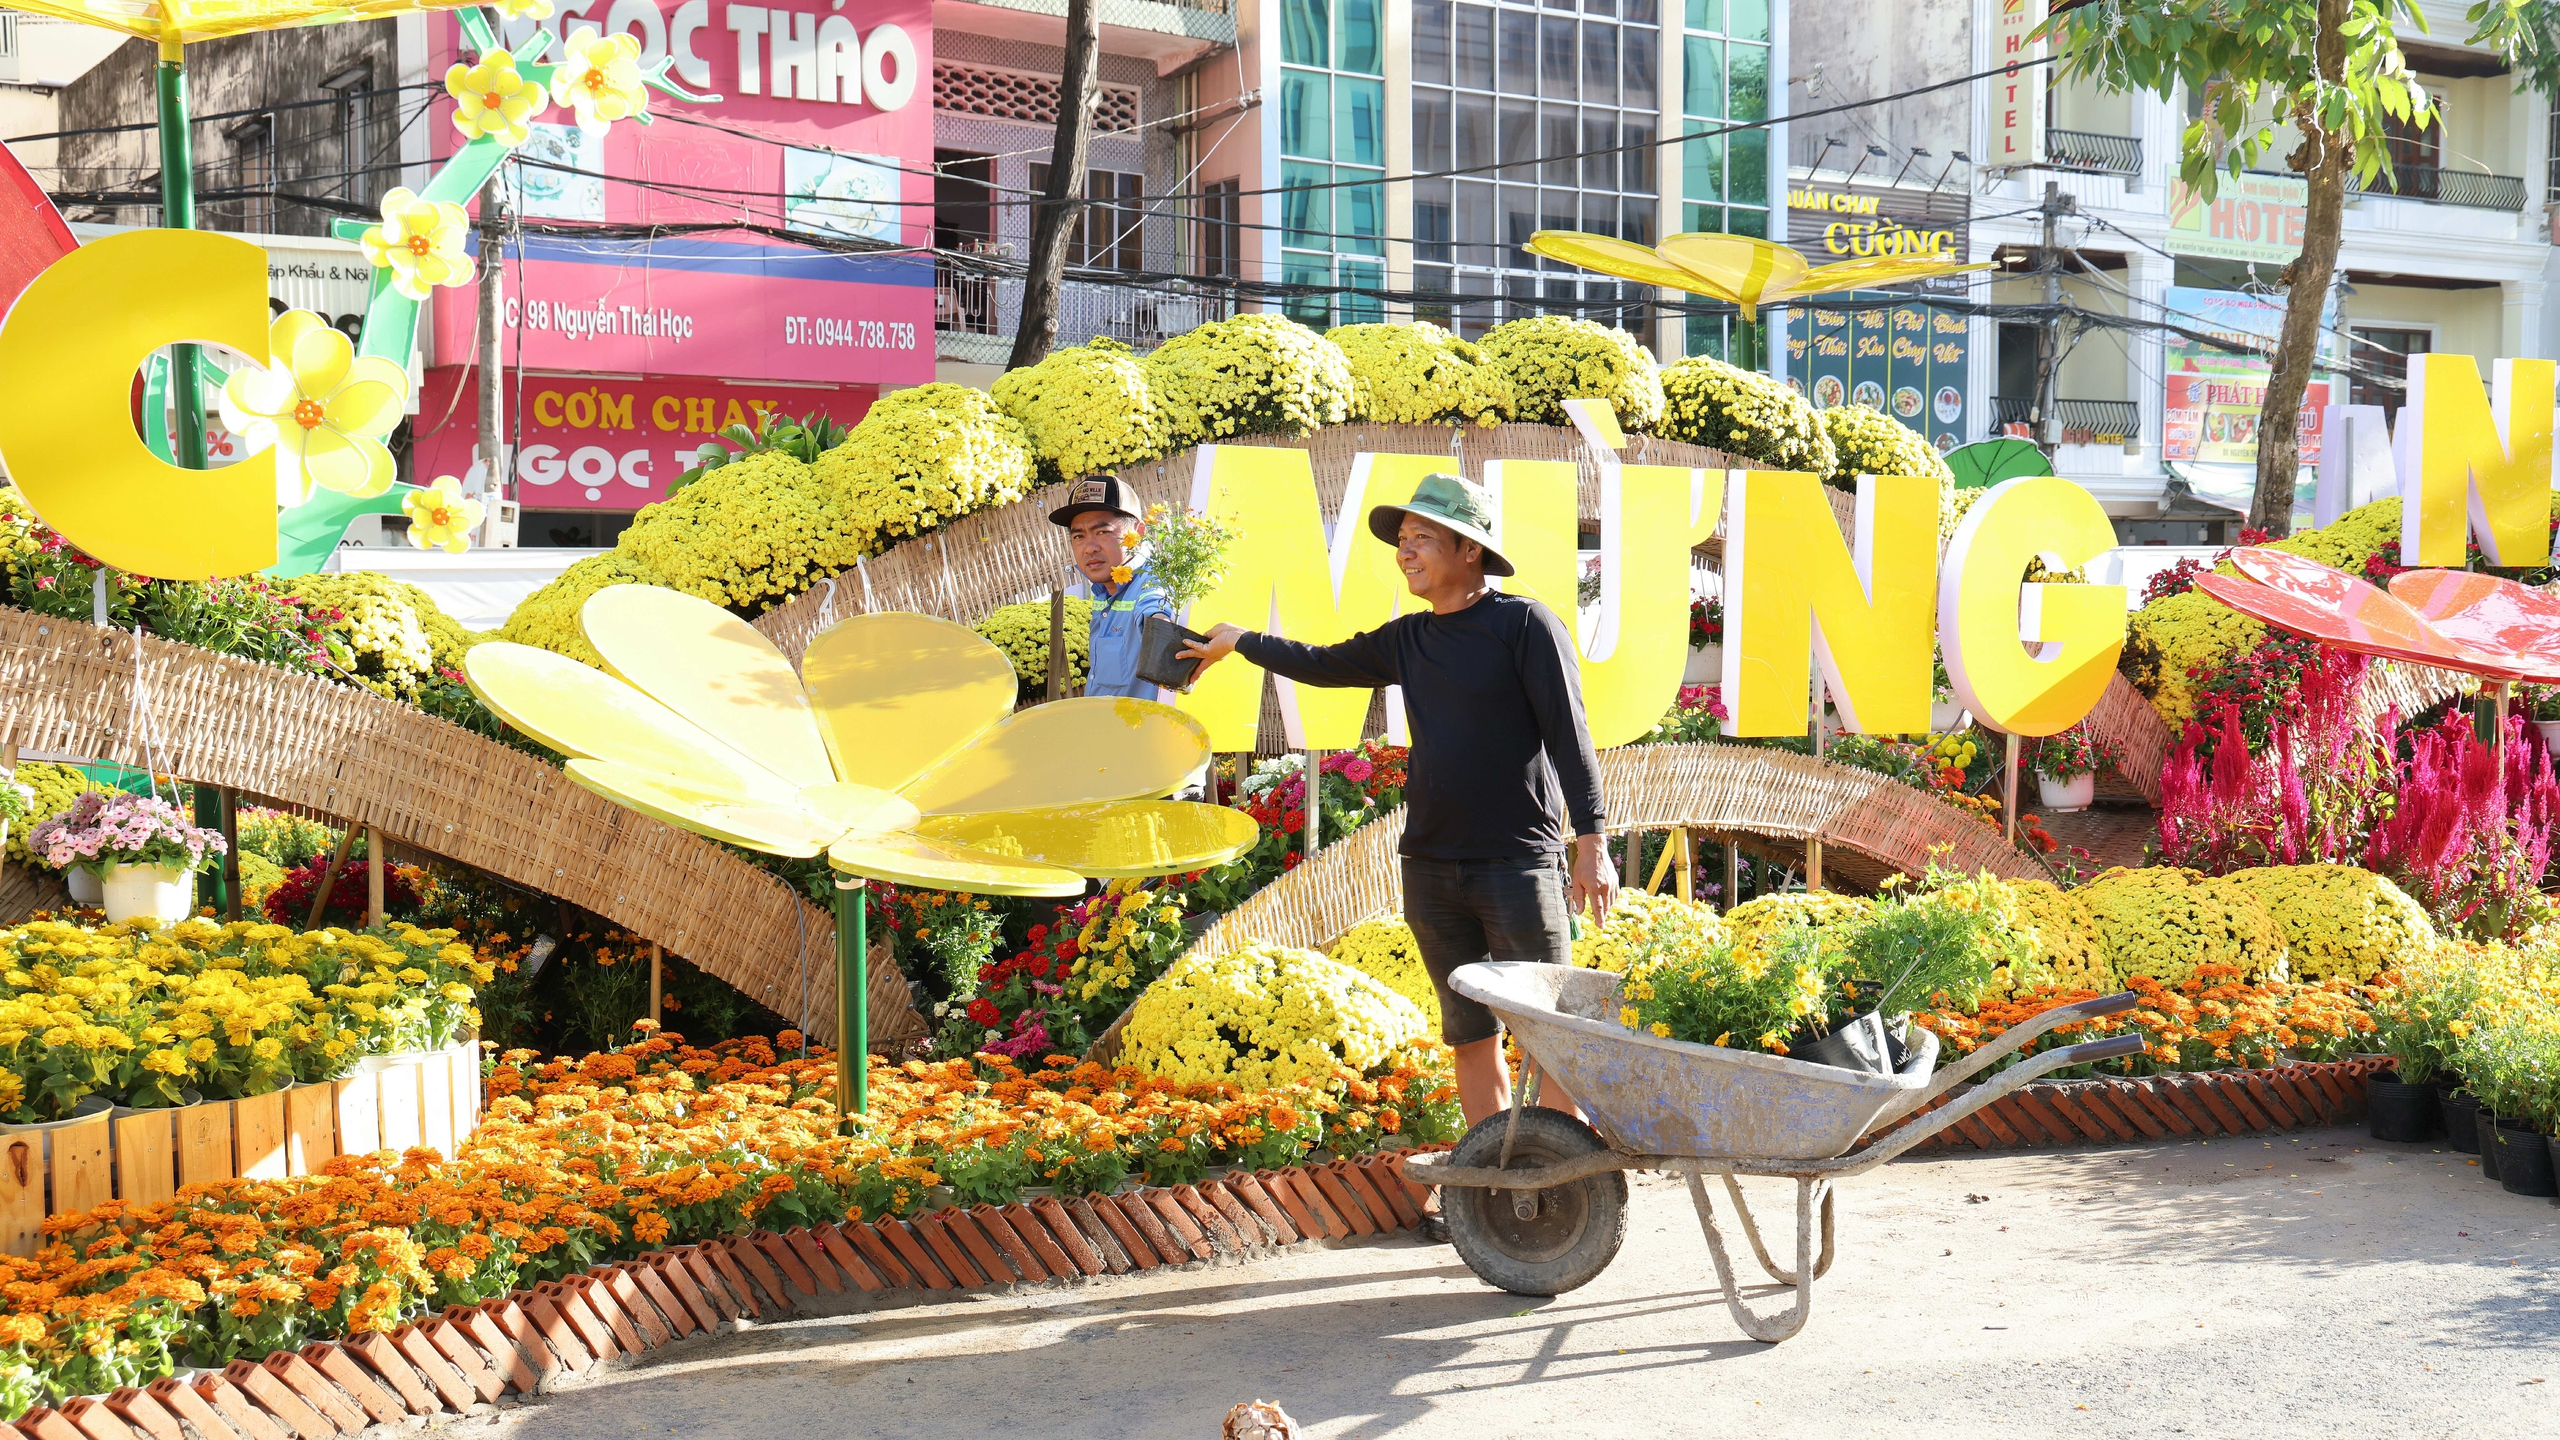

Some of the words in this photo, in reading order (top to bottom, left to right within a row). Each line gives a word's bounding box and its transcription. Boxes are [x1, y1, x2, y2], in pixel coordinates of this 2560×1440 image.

[2004, 14, 2024, 26] NSH
[2005, 34, 2020, 153] HOTEL
[1831, 194, 1880, 215] CHAY
[1823, 217, 1958, 261] CƯỜNG
[2210, 198, 2306, 246] HOTE
[268, 264, 285, 278] ập
[288, 262, 325, 279] Khẩu
[329, 267, 342, 280] &
[345, 268, 369, 284] Nội
[527, 300, 549, 330] 98
[553, 298, 617, 340] Nguyễn
[619, 305, 657, 336] Thái
[660, 308, 693, 343] Học
[785, 316, 812, 345] ĐT:
[815, 317, 916, 350] 0944.738.758
[1892, 336, 1927, 366] Chay
[2206, 380, 2253, 406] PHÁT
[533, 386, 636, 430] CƠM
[652, 395, 778, 435] CHAY
[2095, 433, 2126, 445] HOTEL
[1160, 398, 2128, 752] MỪNG
